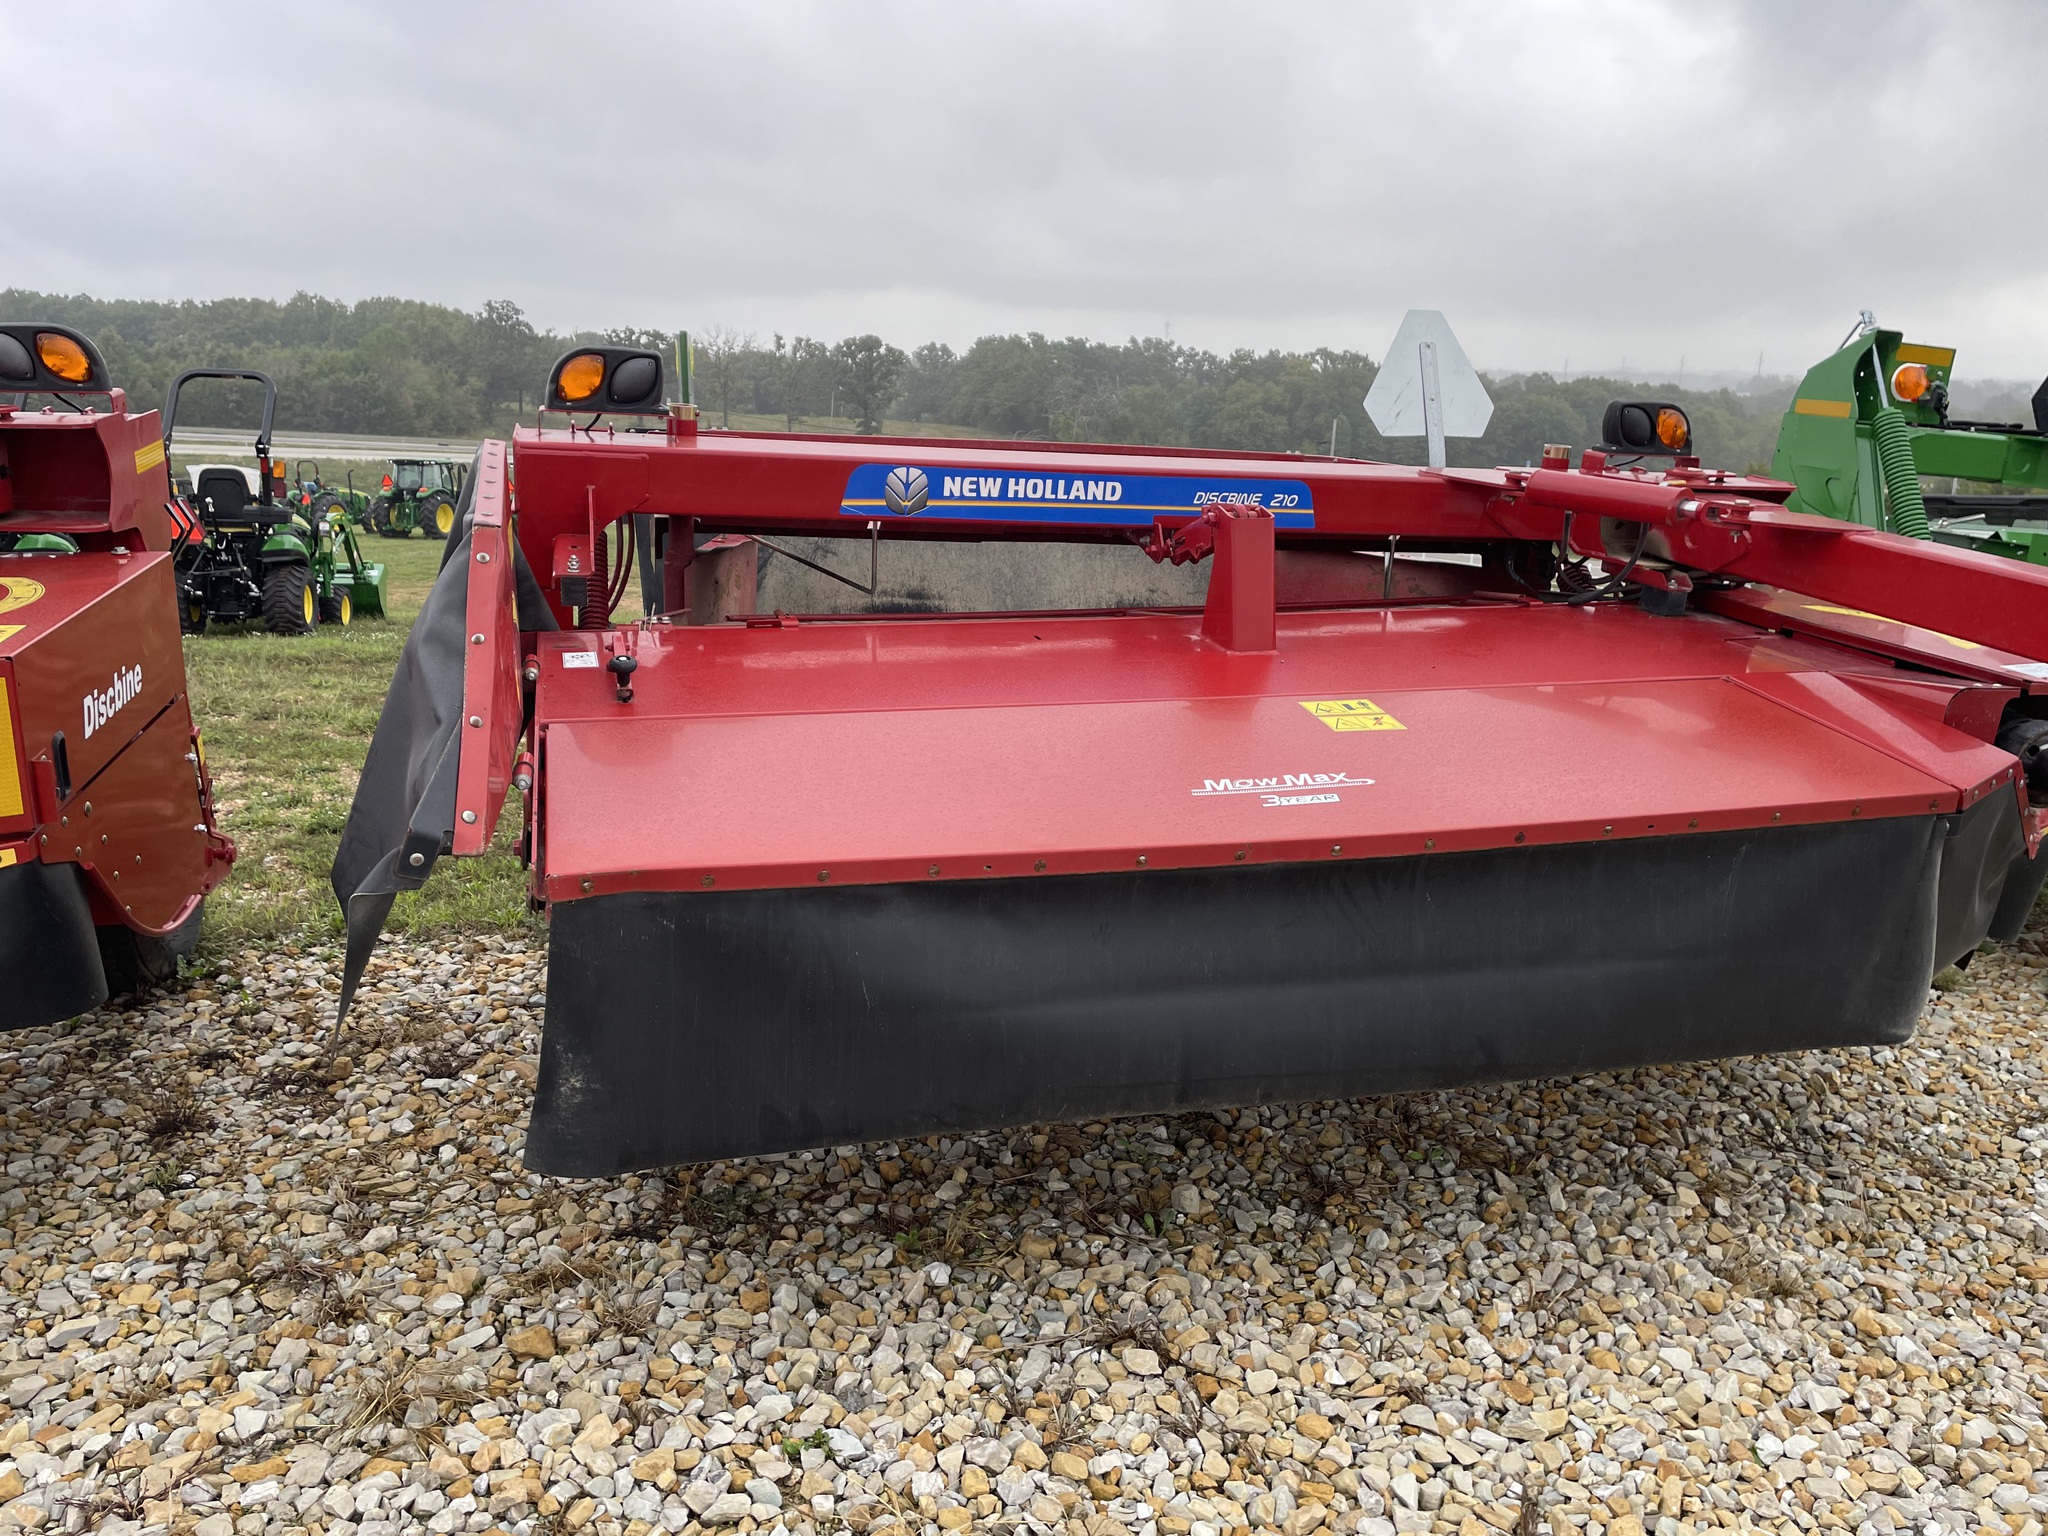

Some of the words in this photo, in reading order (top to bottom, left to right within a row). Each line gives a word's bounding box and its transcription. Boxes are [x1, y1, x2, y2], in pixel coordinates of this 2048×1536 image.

[943, 476, 1002, 498] NEW
[1007, 478, 1122, 501] HOLLAND
[1193, 492, 1263, 505] DISCBINE
[1270, 494, 1298, 506] 210
[83, 664, 142, 739] Discbine
[1203, 778, 1277, 791] Mow
[1283, 772, 1347, 787] Max
